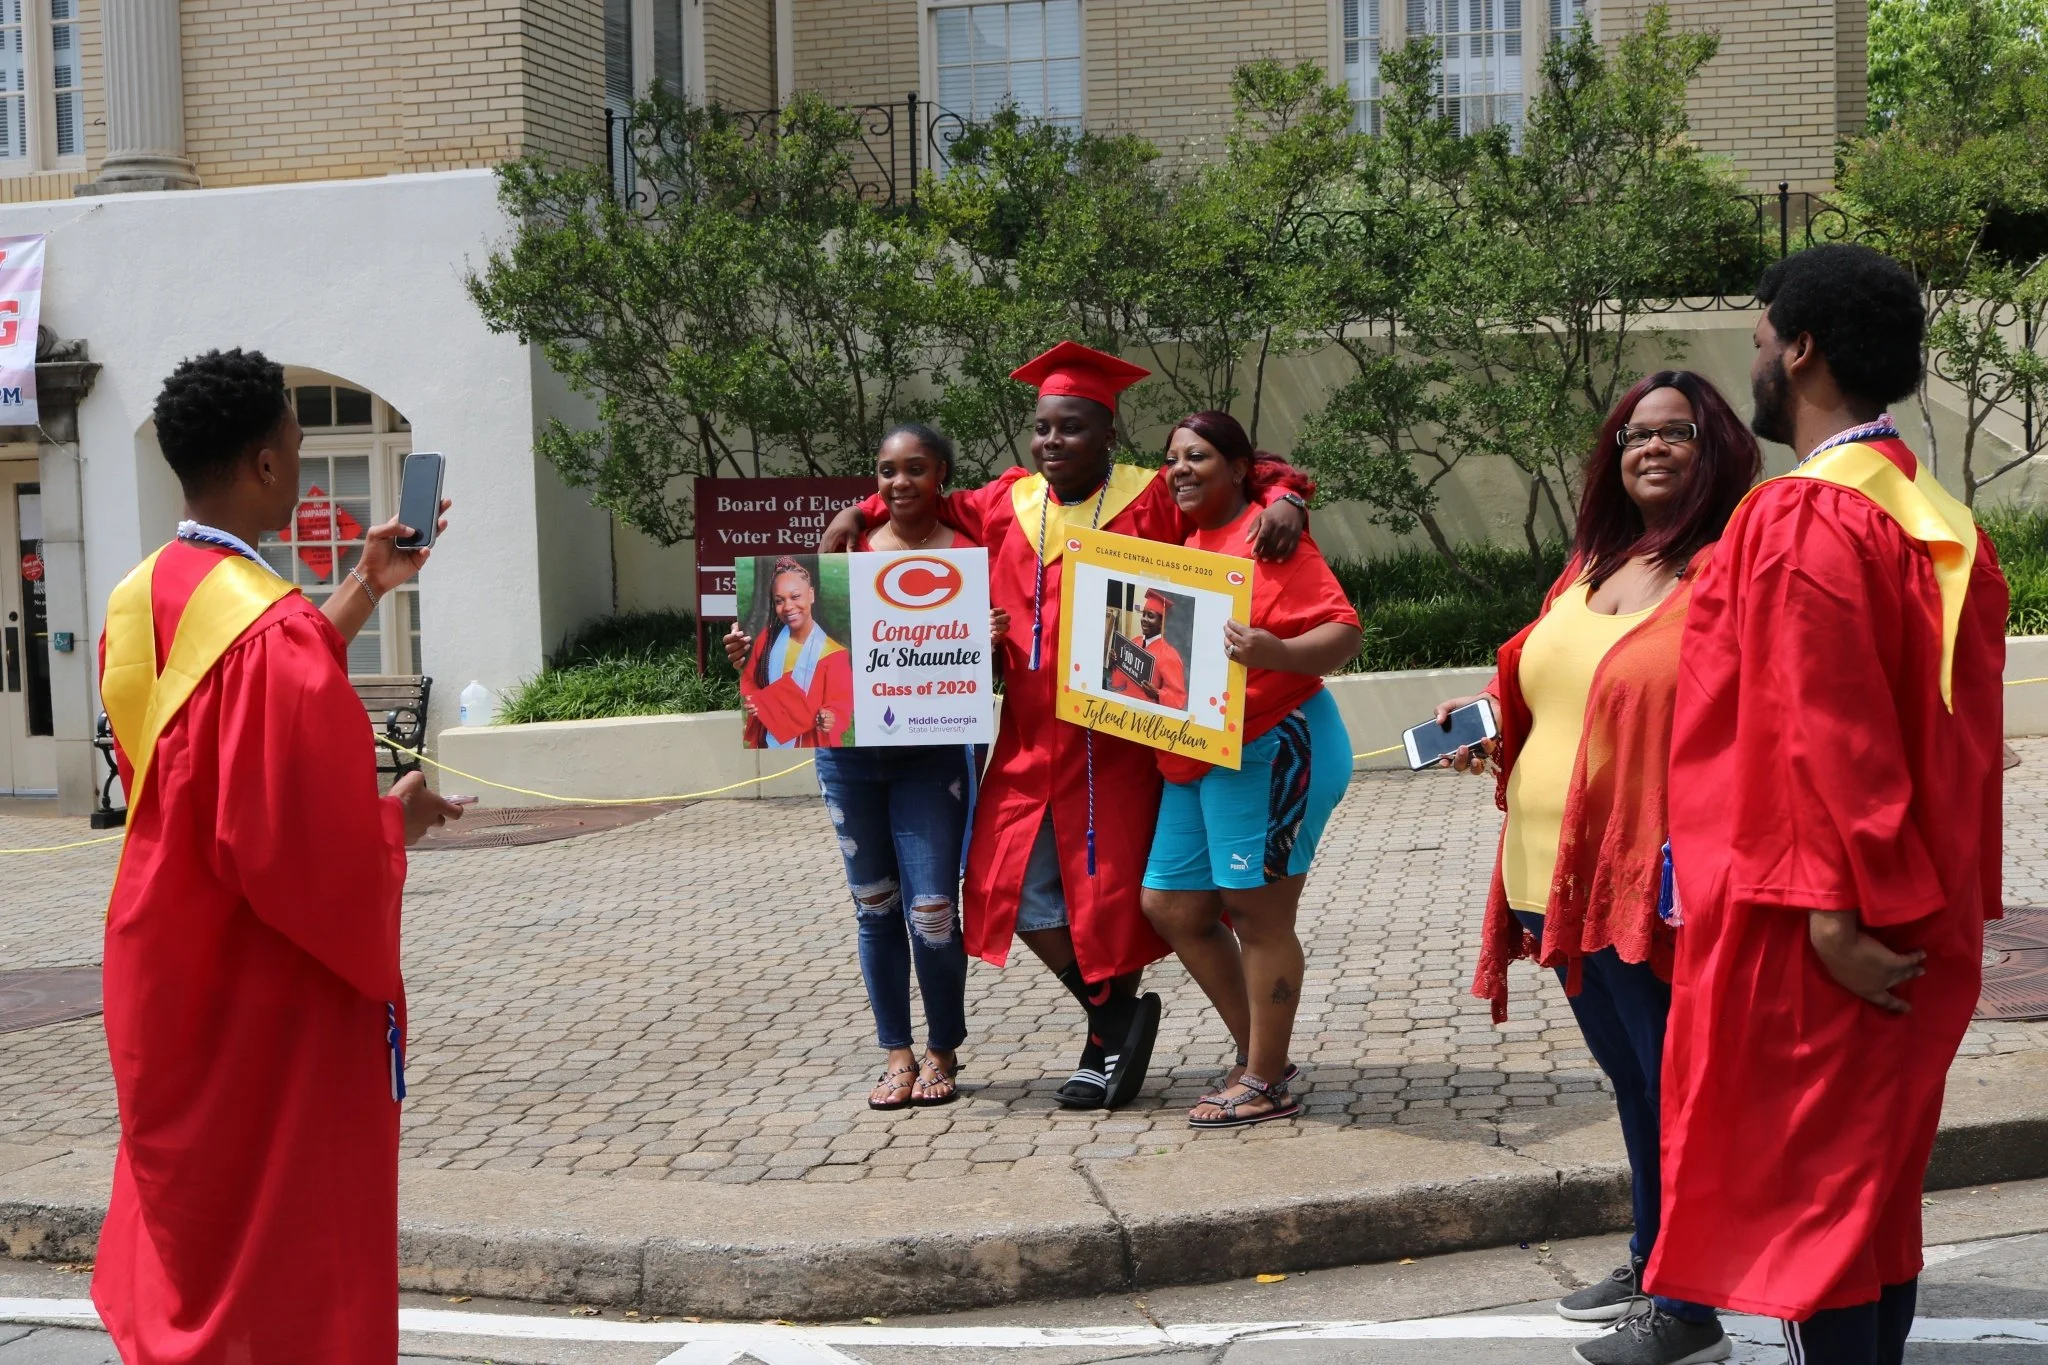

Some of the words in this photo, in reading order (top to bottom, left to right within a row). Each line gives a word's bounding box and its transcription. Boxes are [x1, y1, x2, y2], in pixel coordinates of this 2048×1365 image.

[716, 496, 777, 512] Board
[783, 496, 804, 512] of
[789, 513, 826, 528] and
[717, 529, 771, 544] Voter
[1095, 546, 1121, 559] CLARKE
[1123, 552, 1154, 566] CENTRAL
[1156, 559, 1180, 571] CLASS
[1182, 564, 1193, 573] OF
[1194, 566, 1213, 577] 2020
[871, 619, 972, 648] Congrats
[865, 647, 982, 673] Ja'Shauntee
[872, 682, 913, 698] Class
[916, 681, 933, 697] of
[936, 680, 977, 696] 2020
[908, 716, 939, 727] Middle
[940, 715, 978, 728] Georgia
[908, 726, 928, 735] State
[929, 725, 966, 735] University
[1082, 699, 1128, 729] Tylend
[1130, 711, 1208, 751] Willingham
